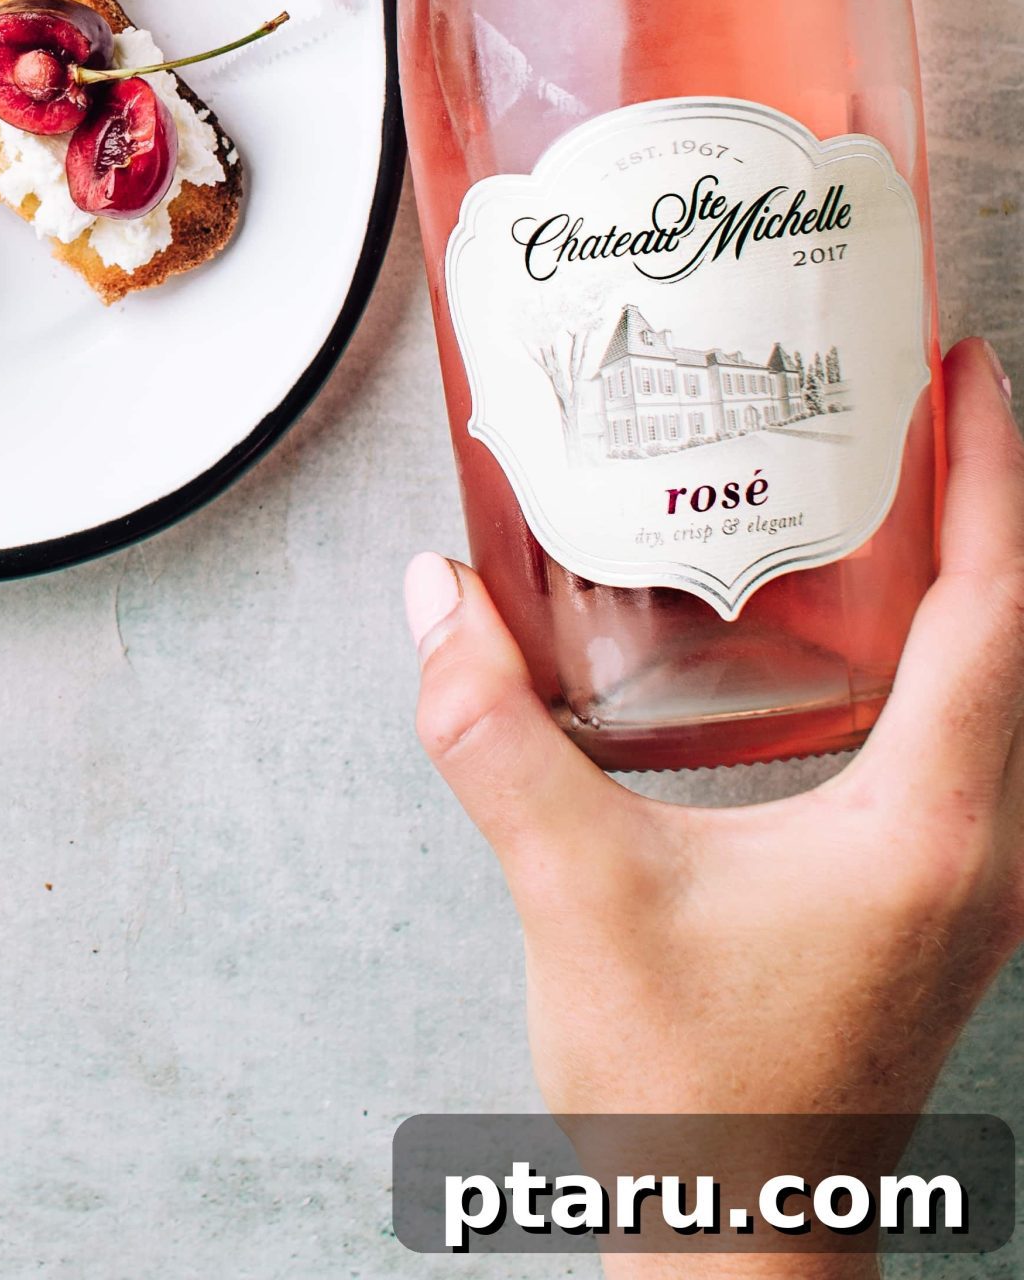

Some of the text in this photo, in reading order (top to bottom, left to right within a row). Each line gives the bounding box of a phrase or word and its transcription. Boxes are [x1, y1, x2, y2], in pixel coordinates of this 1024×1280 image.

[616, 140, 729, 171] EST. 1967
[511, 214, 680, 281] Chateau
[652, 175, 727, 238] Ste
[793, 244, 848, 266] 2017
[665, 469, 769, 514] rosé
[673, 523, 713, 543] crisp
[722, 517, 740, 535] &
[747, 512, 804, 535] elegant
